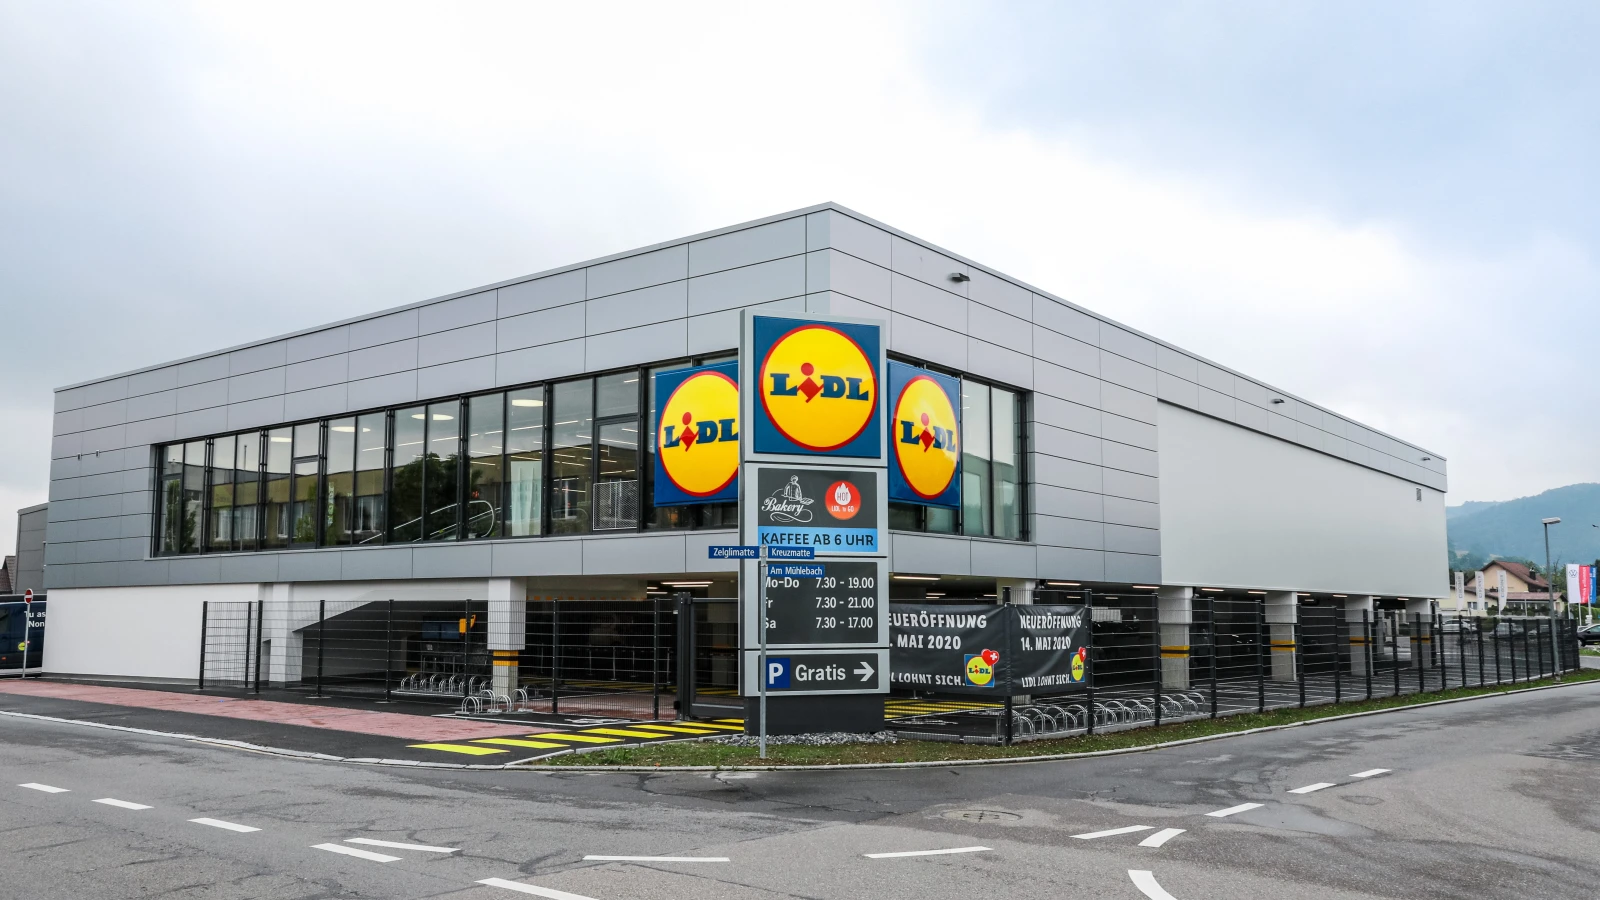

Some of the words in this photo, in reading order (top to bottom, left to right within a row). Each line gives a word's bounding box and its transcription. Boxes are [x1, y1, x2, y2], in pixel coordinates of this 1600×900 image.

[836, 492, 848, 501] HOT
[762, 498, 804, 516] Bakery
[762, 532, 809, 544] KAFFEE
[813, 534, 830, 545] AB
[834, 534, 842, 545] 6
[846, 534, 874, 546] UHR
[714, 548, 754, 558] Zelglimatte
[772, 548, 810, 558] Kreuzmatte
[770, 566, 782, 574] Am
[785, 566, 822, 576] Mühlebach
[816, 577, 836, 588] 7.30
[848, 577, 874, 588] 19.00
[816, 597, 836, 608] 7.30
[848, 597, 874, 608] 21.00
[816, 617, 836, 628] 7.30
[848, 617, 873, 628] 17.00
[1020, 612, 1082, 628] NEUERÖFFNUNG
[897, 634, 924, 648] MAI
[928, 635, 962, 650] 2020
[1020, 636, 1033, 650] 14.
[1036, 636, 1052, 650] MAI
[1052, 636, 1072, 650] 2020
[769, 663, 784, 684] P
[795, 664, 846, 681] Gratis
[898, 672, 932, 684] LOHNT
[935, 675, 966, 686] SICH.
[1022, 676, 1036, 688] LIDL
